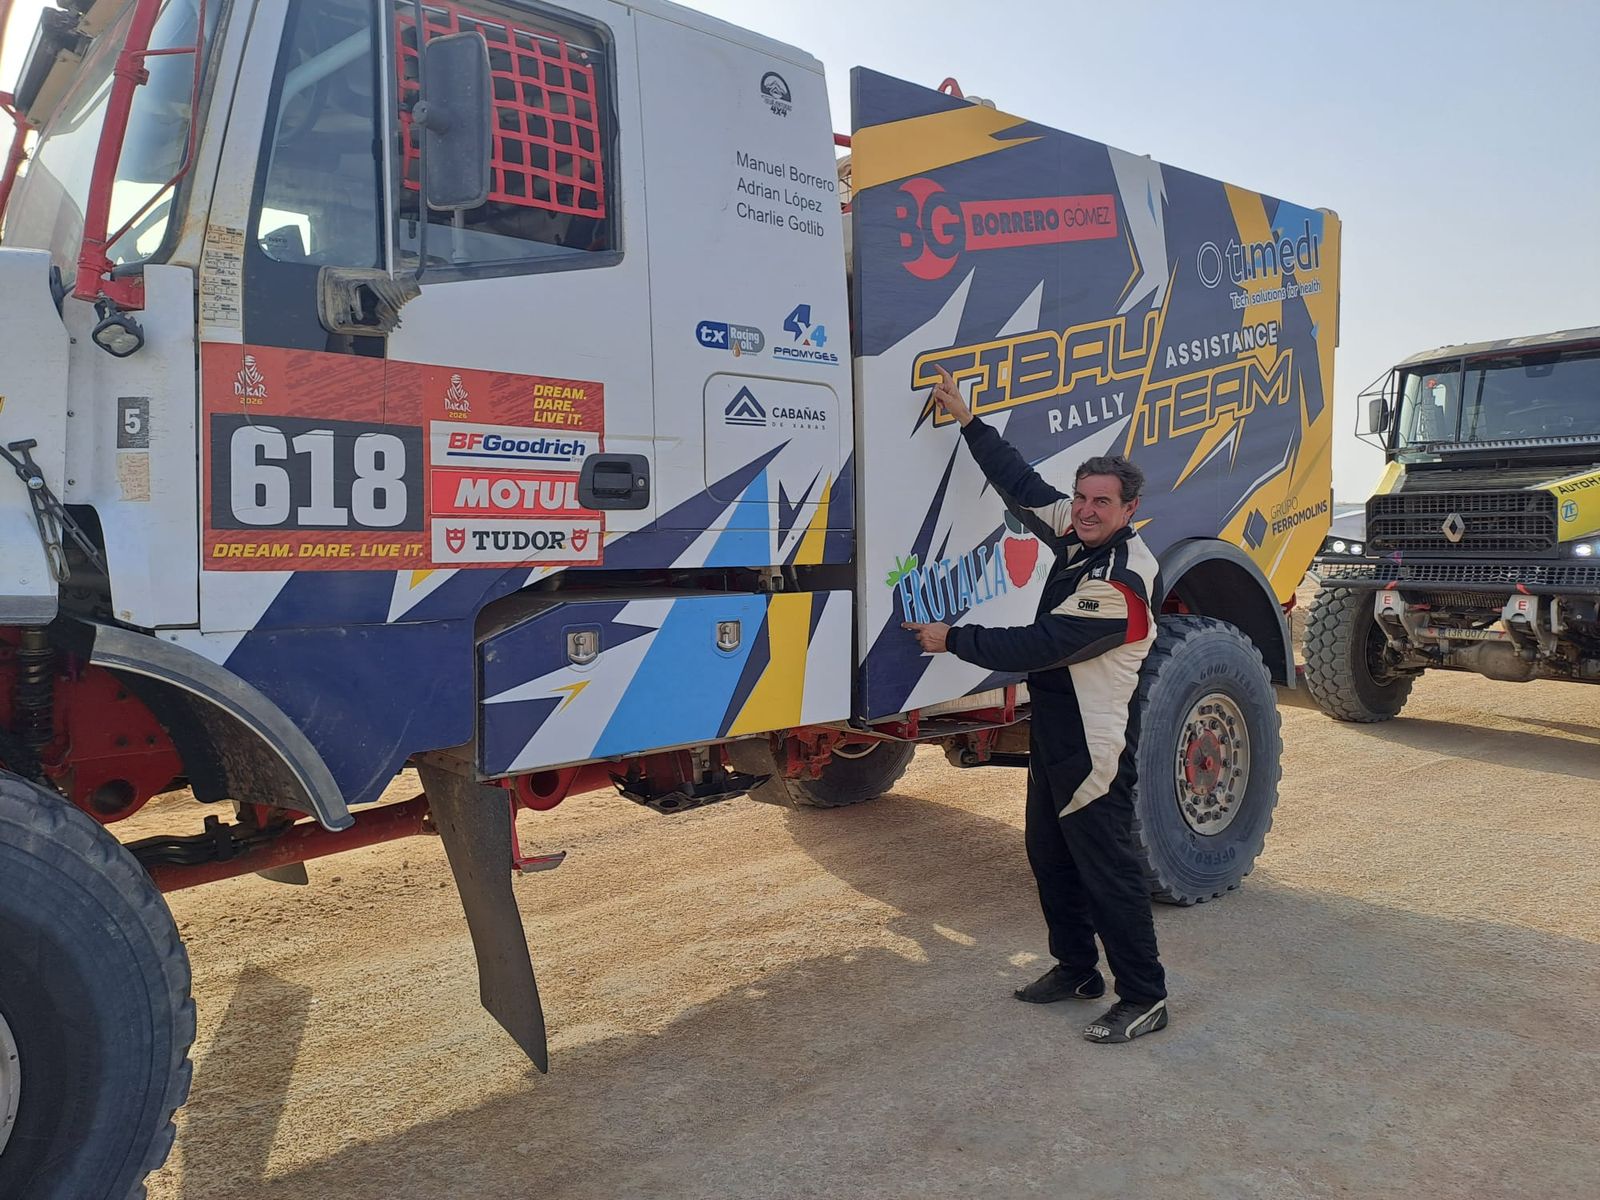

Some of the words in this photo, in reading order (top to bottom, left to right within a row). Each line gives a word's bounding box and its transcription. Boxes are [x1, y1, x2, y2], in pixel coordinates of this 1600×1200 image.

[736, 151, 785, 178] Manuel
[790, 166, 834, 193] Borrero
[737, 177, 780, 202] Adrian
[785, 188, 822, 213] López
[736, 202, 784, 227] Charlie
[788, 215, 824, 237] Gotlib
[971, 209, 1060, 237] BORRERO
[1063, 202, 1112, 228] GÓMEZ
[1229, 292, 1250, 310] Tech
[1250, 286, 1286, 305] solutions
[1287, 283, 1299, 299] for
[1299, 279, 1321, 296] health
[730, 326, 760, 344] Racing
[773, 346, 838, 362] PROMYGES
[1165, 321, 1278, 369] ASSISTANCE
[234, 381, 268, 398] DAKAR
[533, 384, 587, 400] DREAM.
[1138, 348, 1293, 447] TEAM
[240, 397, 263, 405] 2026
[444, 398, 472, 413] DAKAR
[533, 398, 575, 412] DARE.
[124, 408, 141, 434] 5
[449, 411, 468, 419] 2026
[533, 411, 565, 424] LIVE
[567, 413, 583, 425] IT.
[772, 406, 826, 421] CABAÑAS
[1048, 392, 1126, 434] RALLY
[448, 432, 586, 456] BFGoodrich
[230, 425, 407, 527] 618
[1557, 476, 1600, 495] AUTOH
[453, 478, 583, 509] MOTUL
[1270, 496, 1299, 519] GRUPO
[1271, 500, 1328, 536] FERROMOLINS
[212, 543, 294, 558] DREAM.
[298, 543, 356, 558] DARE.
[360, 543, 400, 557] LIVE
[403, 543, 424, 557] IT.
[472, 531, 566, 551] TUDOR
[899, 541, 1008, 624] FRUTALIA
[1077, 600, 1100, 611] OMP
[1383, 595, 1392, 605] E
[1518, 600, 1527, 611] E
[1084, 1025, 1111, 1038] OMP
